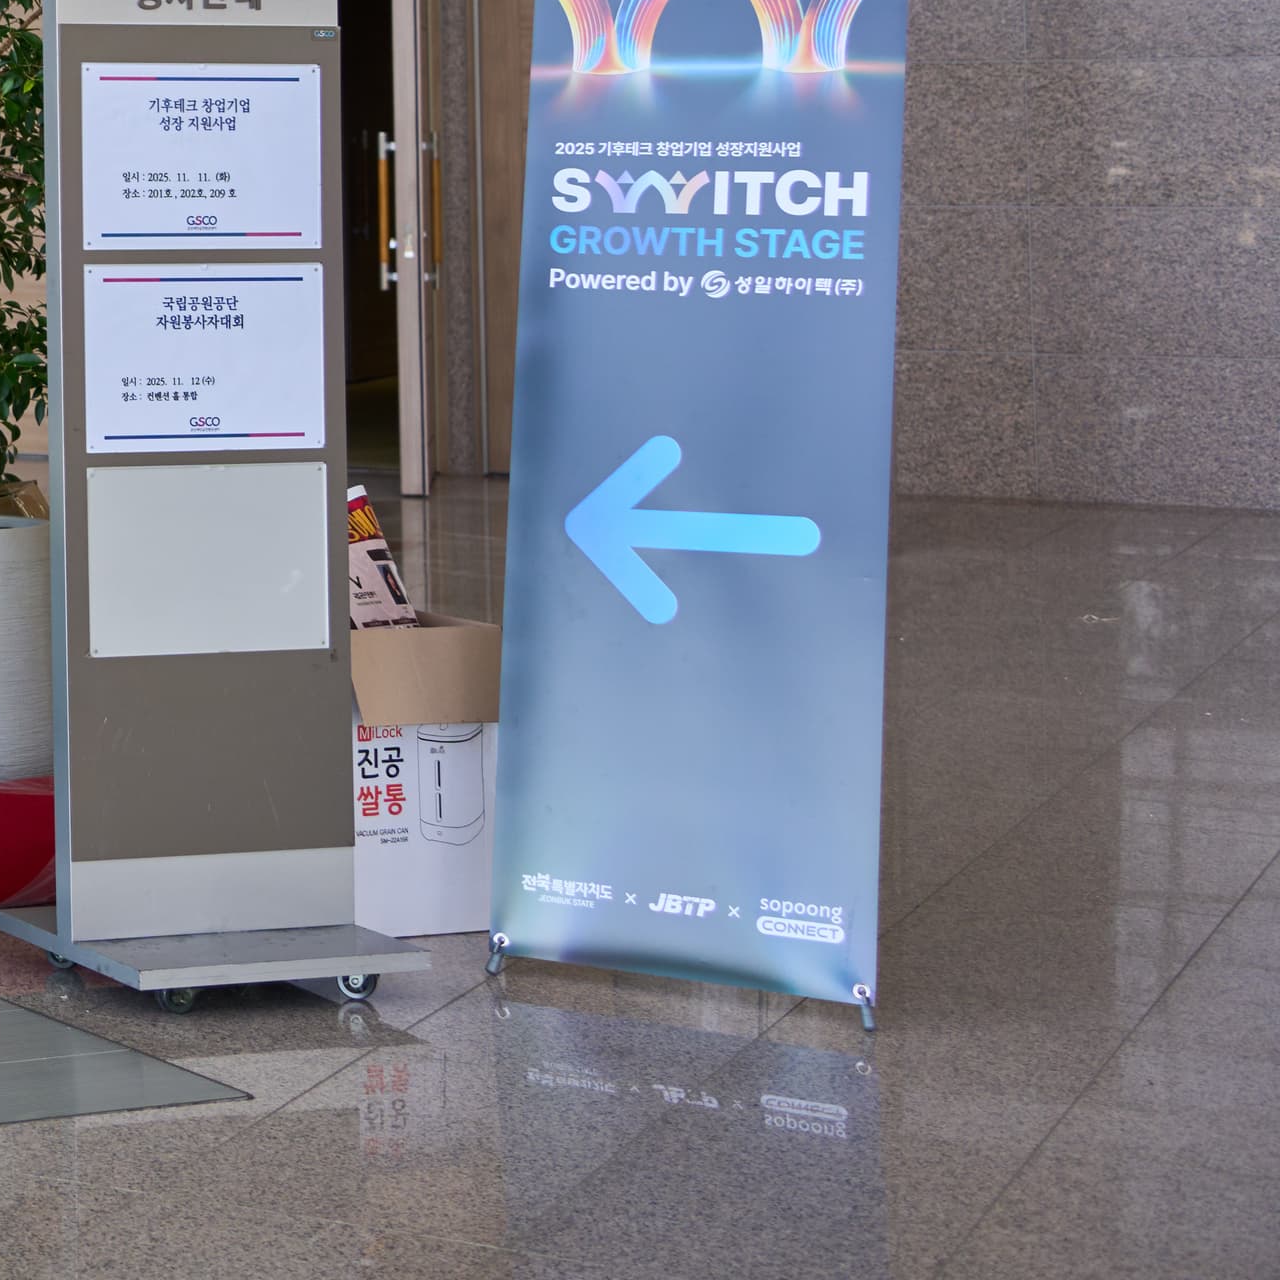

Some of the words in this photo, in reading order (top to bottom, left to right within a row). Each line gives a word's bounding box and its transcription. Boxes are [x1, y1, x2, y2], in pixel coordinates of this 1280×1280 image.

[148, 98, 199, 113] 기후테크
[202, 98, 251, 114] 창업기업
[159, 116, 184, 131] 성장
[188, 116, 237, 131] 지원사업
[554, 142, 595, 156] 2025
[597, 141, 653, 157] 기후테크
[656, 141, 713, 157] 창업기업
[715, 141, 802, 158] 성장지원사업
[122, 171, 140, 183] 일시
[147, 173, 171, 182] 2025.
[215, 172, 231, 183] (화)
[122, 188, 140, 199] 장소
[209, 189, 226, 199] 209
[551, 167, 868, 217] SWITCH
[186, 216, 218, 226] GSCO
[549, 224, 724, 257] GROWTH
[734, 228, 865, 260] STAGE
[549, 267, 657, 292] Powered
[663, 271, 694, 296] by
[162, 296, 239, 312] 국립공원공단
[155, 314, 245, 330] 자원봉사자대회
[121, 376, 137, 387] 일시
[121, 391, 138, 402] 장소
[189, 416, 220, 427] GSCO
[357, 746, 404, 779] 진공
[357, 783, 407, 817] 쌀통
[521, 872, 614, 900] 전북특별자치도
[572, 899, 595, 909] STATE
[648, 892, 716, 918] JBTP
[759, 896, 843, 925] sopoong
[759, 918, 842, 942] CONNECT
